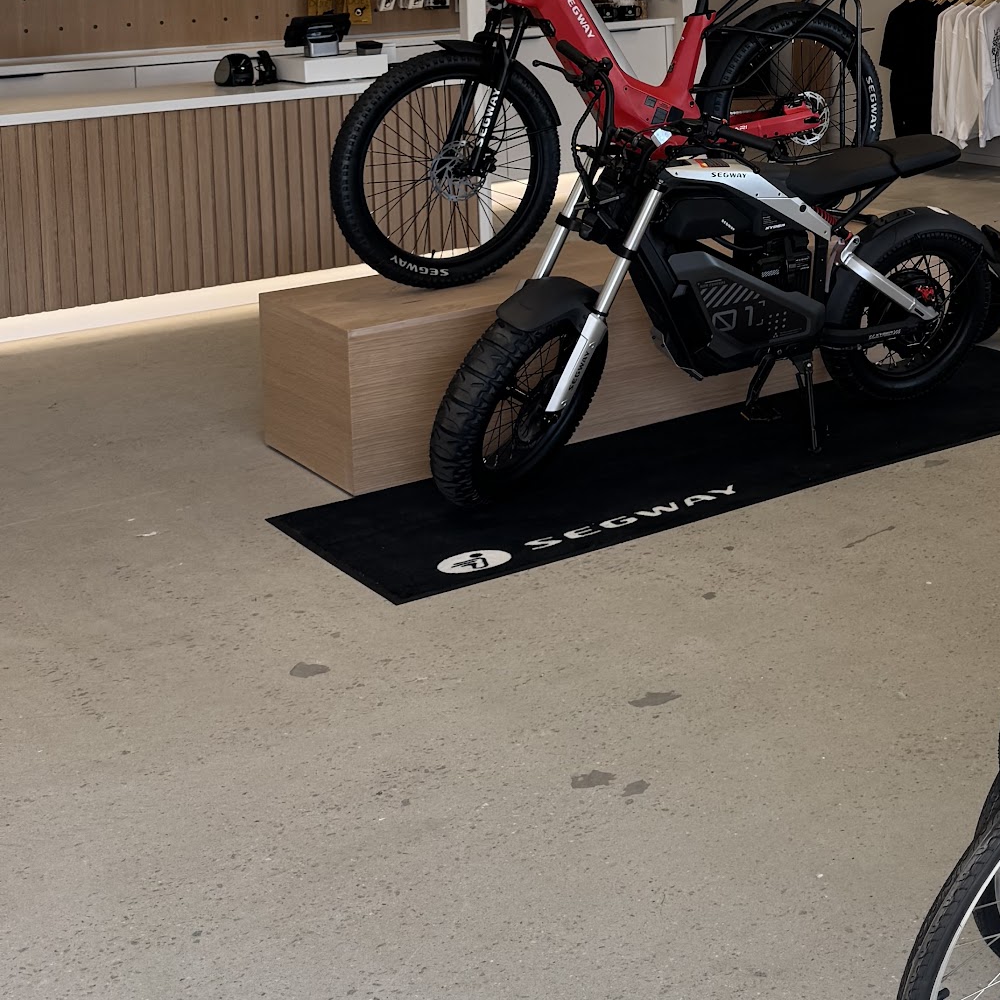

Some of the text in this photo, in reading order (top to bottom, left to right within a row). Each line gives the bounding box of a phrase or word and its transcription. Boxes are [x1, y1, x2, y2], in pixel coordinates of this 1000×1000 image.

[475, 88, 501, 148] SEGWAY
[866, 75, 877, 132] SEGWAY
[390, 255, 449, 277] SEGWAY
[568, 351, 590, 391] SEGWAY
[524, 484, 737, 551] SEGWAY
